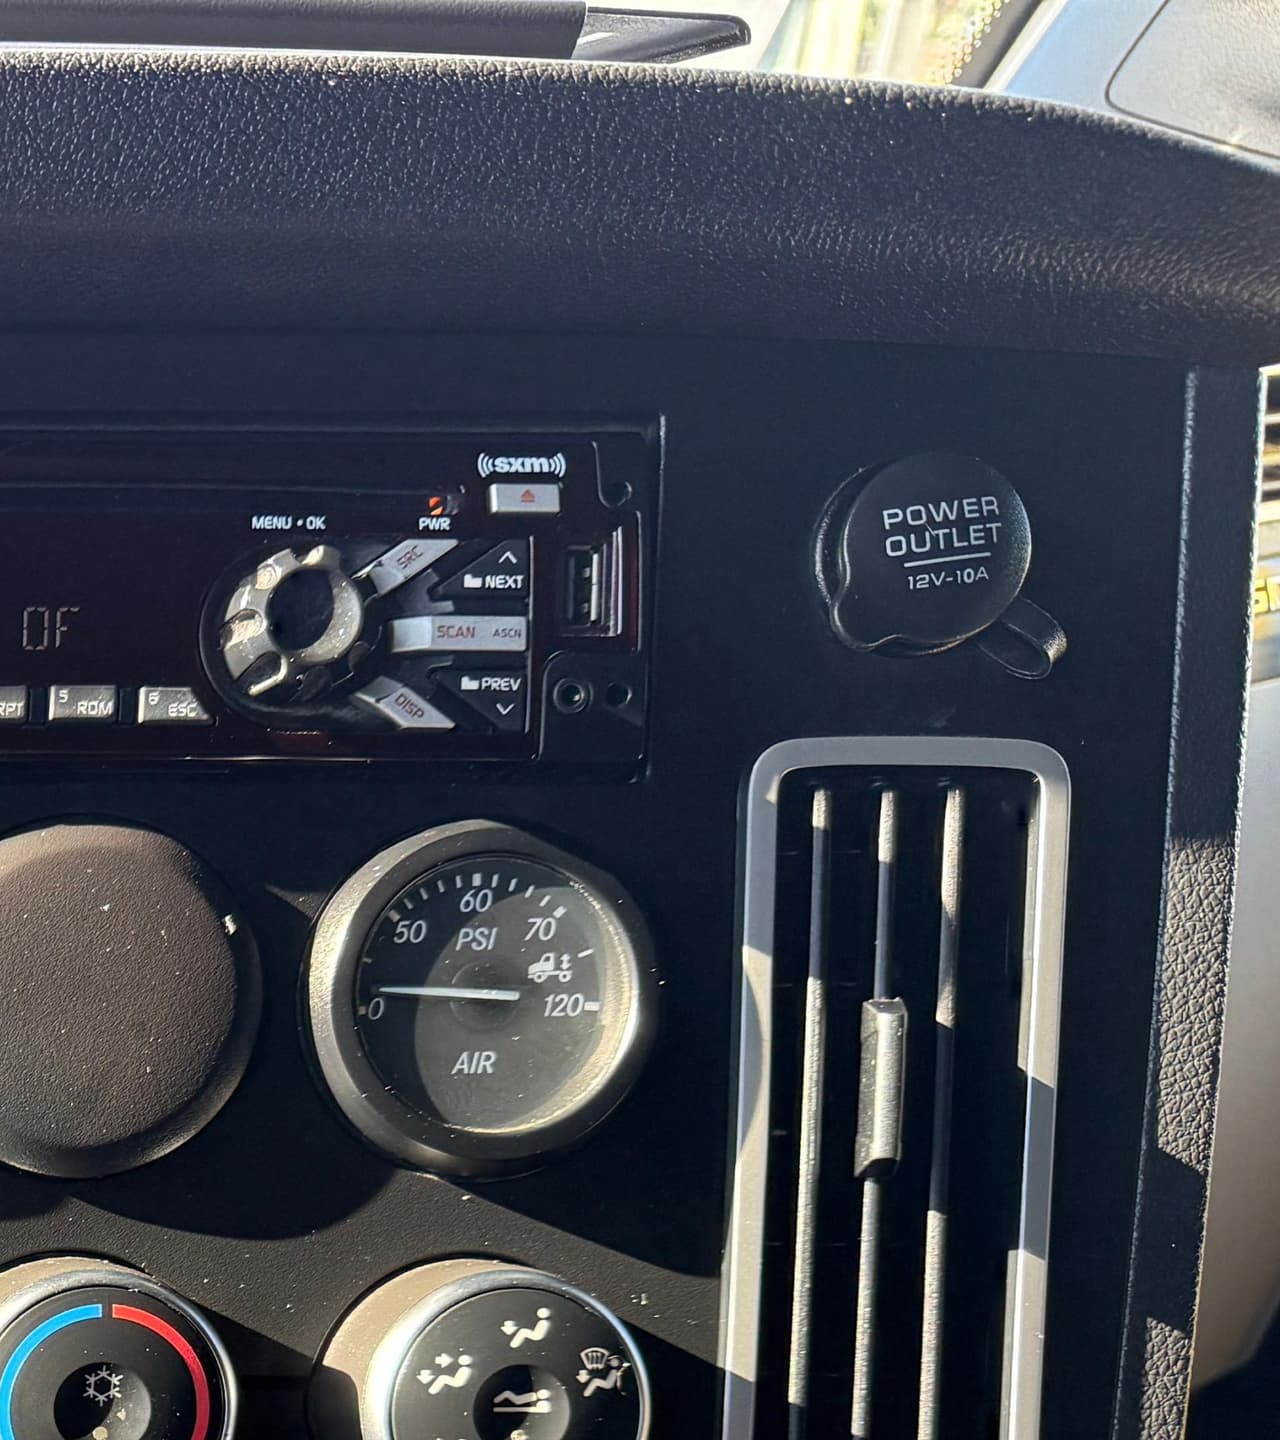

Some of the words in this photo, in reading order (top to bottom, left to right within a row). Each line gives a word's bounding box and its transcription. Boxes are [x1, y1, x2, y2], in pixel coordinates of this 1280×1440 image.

[251, 515, 293, 531] MENU
[305, 515, 327, 531] OK
[418, 516, 451, 531] PWR
[882, 496, 1000, 530] POWER
[885, 522, 1002, 557] OUTLET
[396, 545, 424, 569] SRC
[484, 575, 524, 589] NEXT
[907, 566, 989, 590] 12V-10A
[22, 606, 81, 650] OF
[436, 625, 476, 639] SCAN
[491, 628, 522, 639] ASCN
[481, 677, 522, 691] PREV
[58, 690, 69, 703] 5
[394, 692, 425, 719] DISP
[167, 703, 199, 718] ESC
[459, 889, 493, 913] 60
[393, 920, 428, 944] 50
[455, 927, 498, 951] PSI
[522, 917, 557, 942] 70
[367, 997, 385, 1021] 0
[543, 993, 585, 1018] 120
[451, 1051, 498, 1075] AIR
